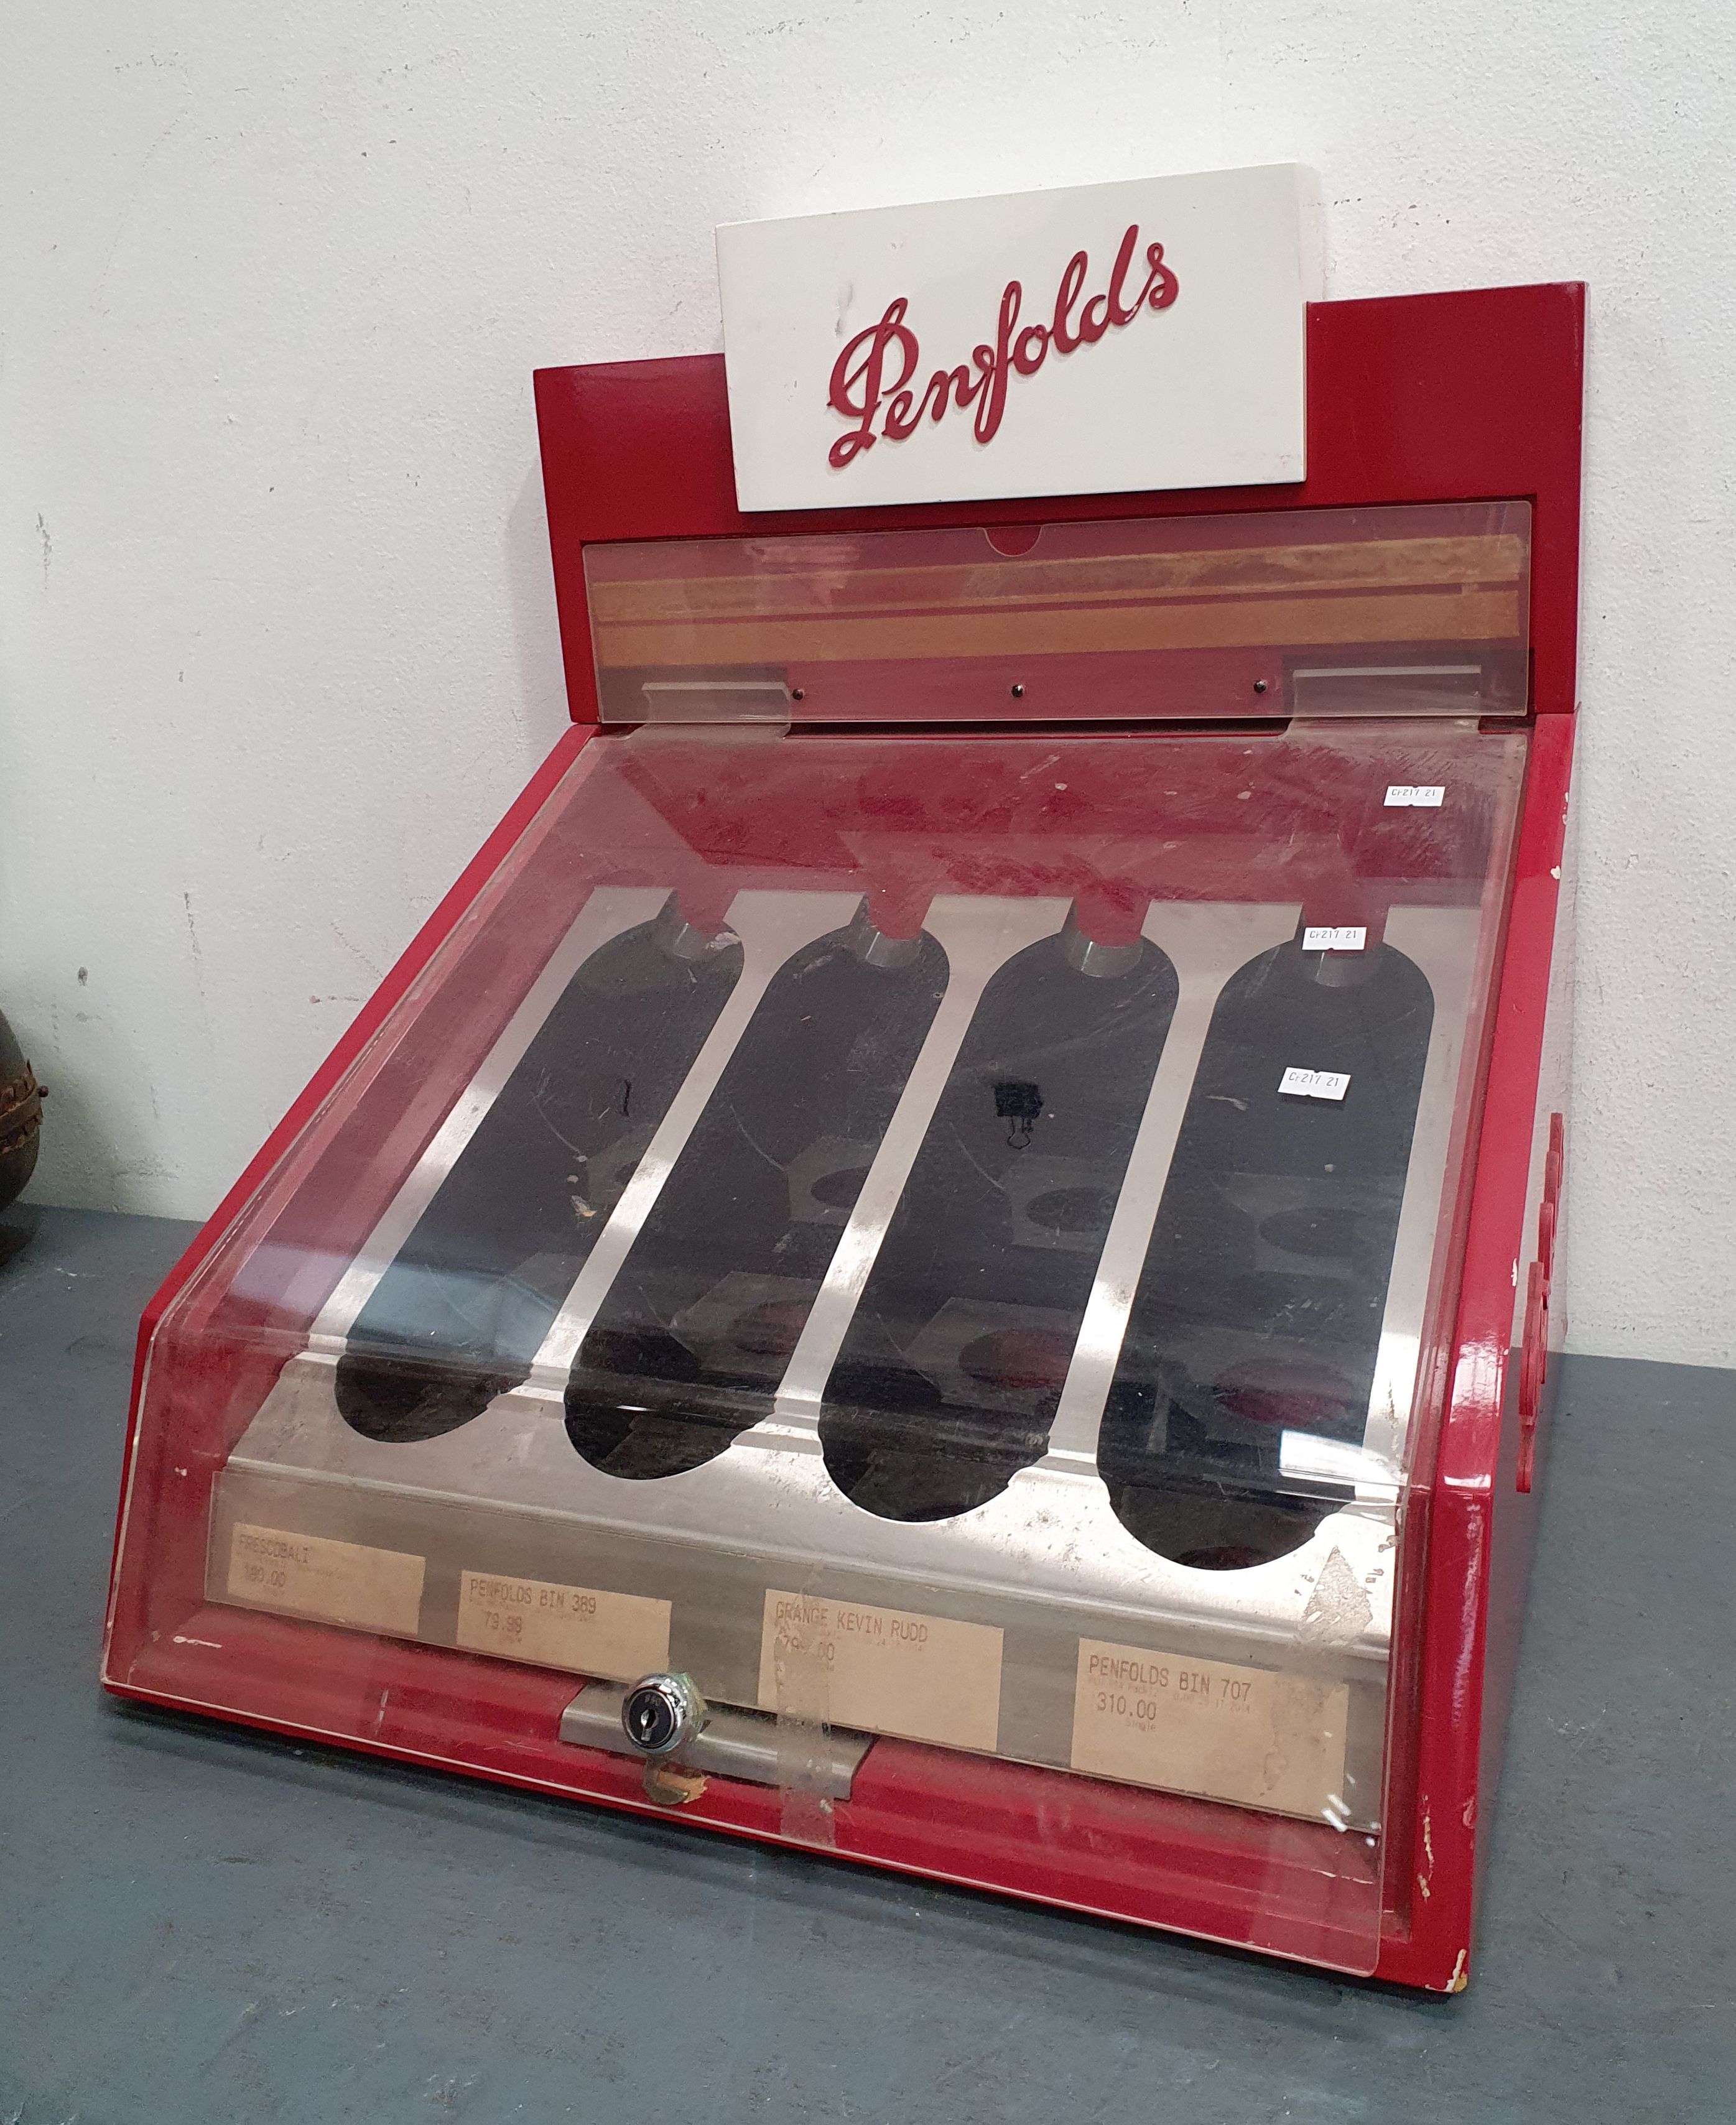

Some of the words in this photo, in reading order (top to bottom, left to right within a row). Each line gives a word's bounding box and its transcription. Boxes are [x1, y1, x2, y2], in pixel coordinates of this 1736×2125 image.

[827, 225, 1179, 468] Penfolds
[1424, 789, 1436, 797] 21
[1345, 930, 1357, 938] 21
[1326, 1076, 1339, 1087] 21
[470, 1578, 532, 1604] PENFOLDS
[539, 1590, 565, 1608] BIN
[572, 1594, 597, 1614] 389
[837, 1610, 883, 1635] KEVIN
[891, 1619, 929, 1643] RUDD
[1089, 1654, 1169, 1687] PENFOLDS
[1179, 1672, 1210, 1695] BIN
[1221, 1678, 1251, 1702] 707
[1097, 1692, 1157, 1720] 310.00
